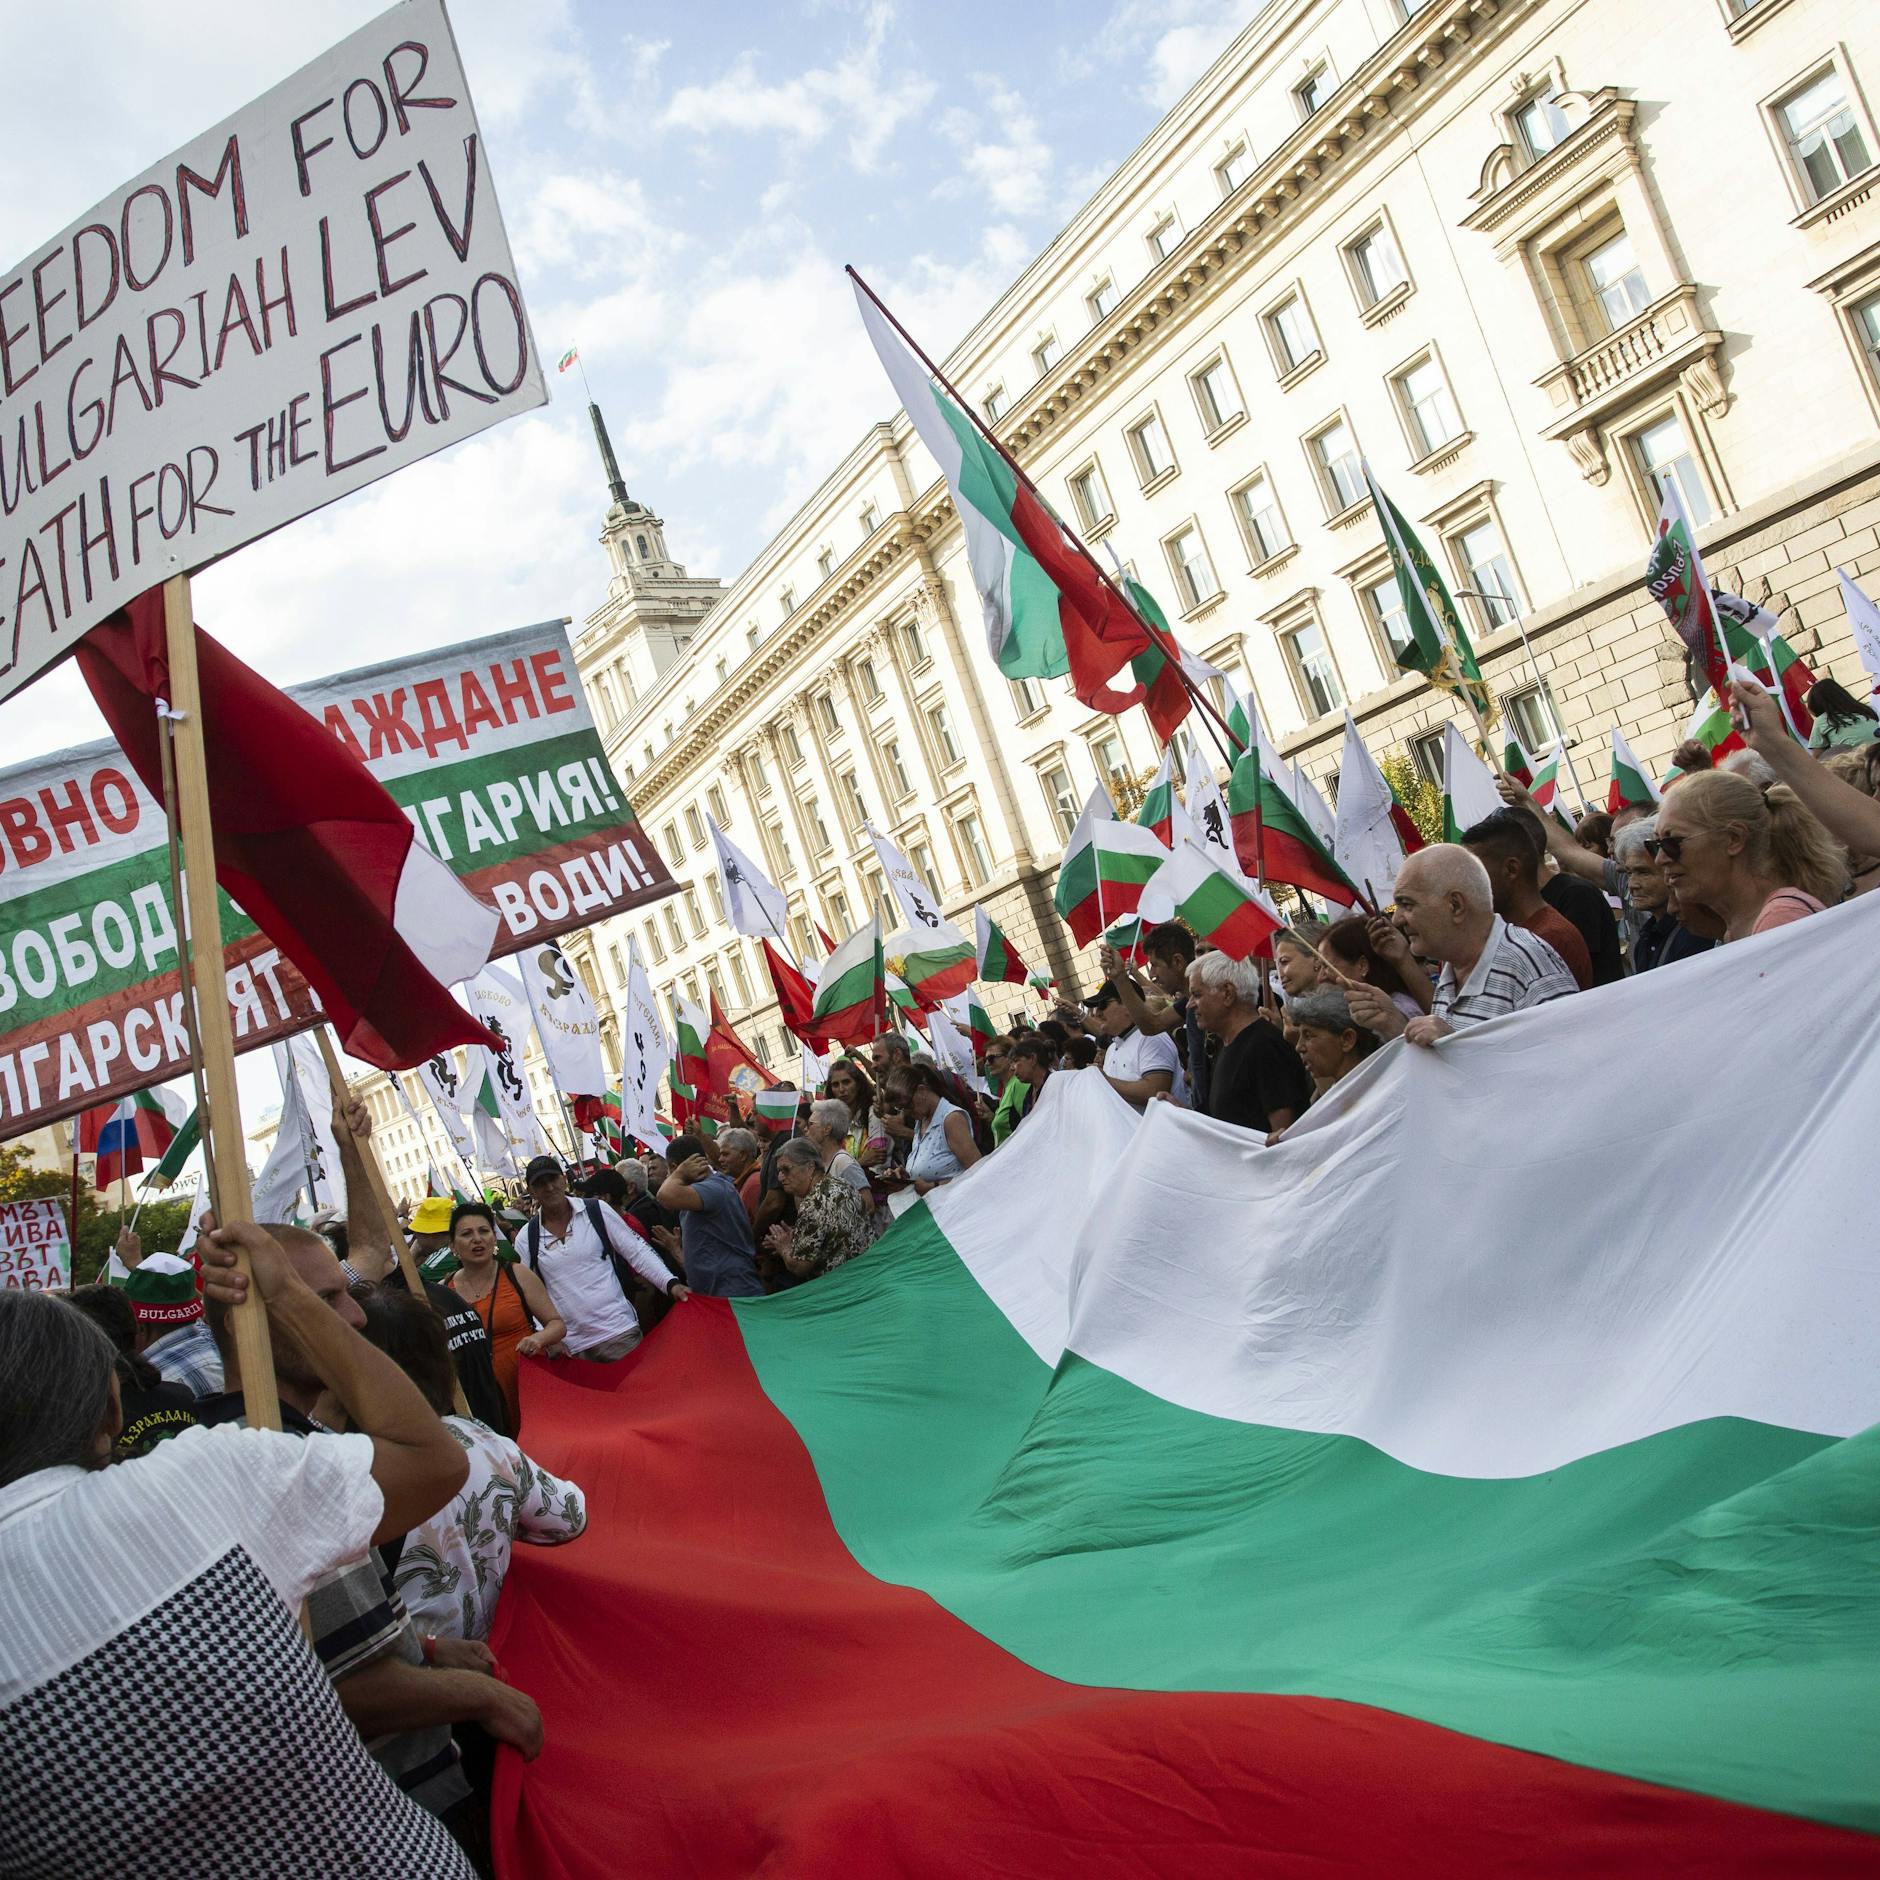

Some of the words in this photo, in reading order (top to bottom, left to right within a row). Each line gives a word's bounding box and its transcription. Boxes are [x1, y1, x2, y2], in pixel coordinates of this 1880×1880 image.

[290, 41, 457, 197] FOR
[319, 133, 477, 321] LEV
[0, 475, 119, 677] ATH
[129, 445, 236, 565] FOR
[234, 392, 318, 490] THE
[319, 272, 528, 476] EURO
[0, 767, 140, 876] ВНО
[491, 839, 655, 936] ВОДИ!
[5, 1219, 62, 1247] ИВА
[171, 1177, 198, 1193] pwc
